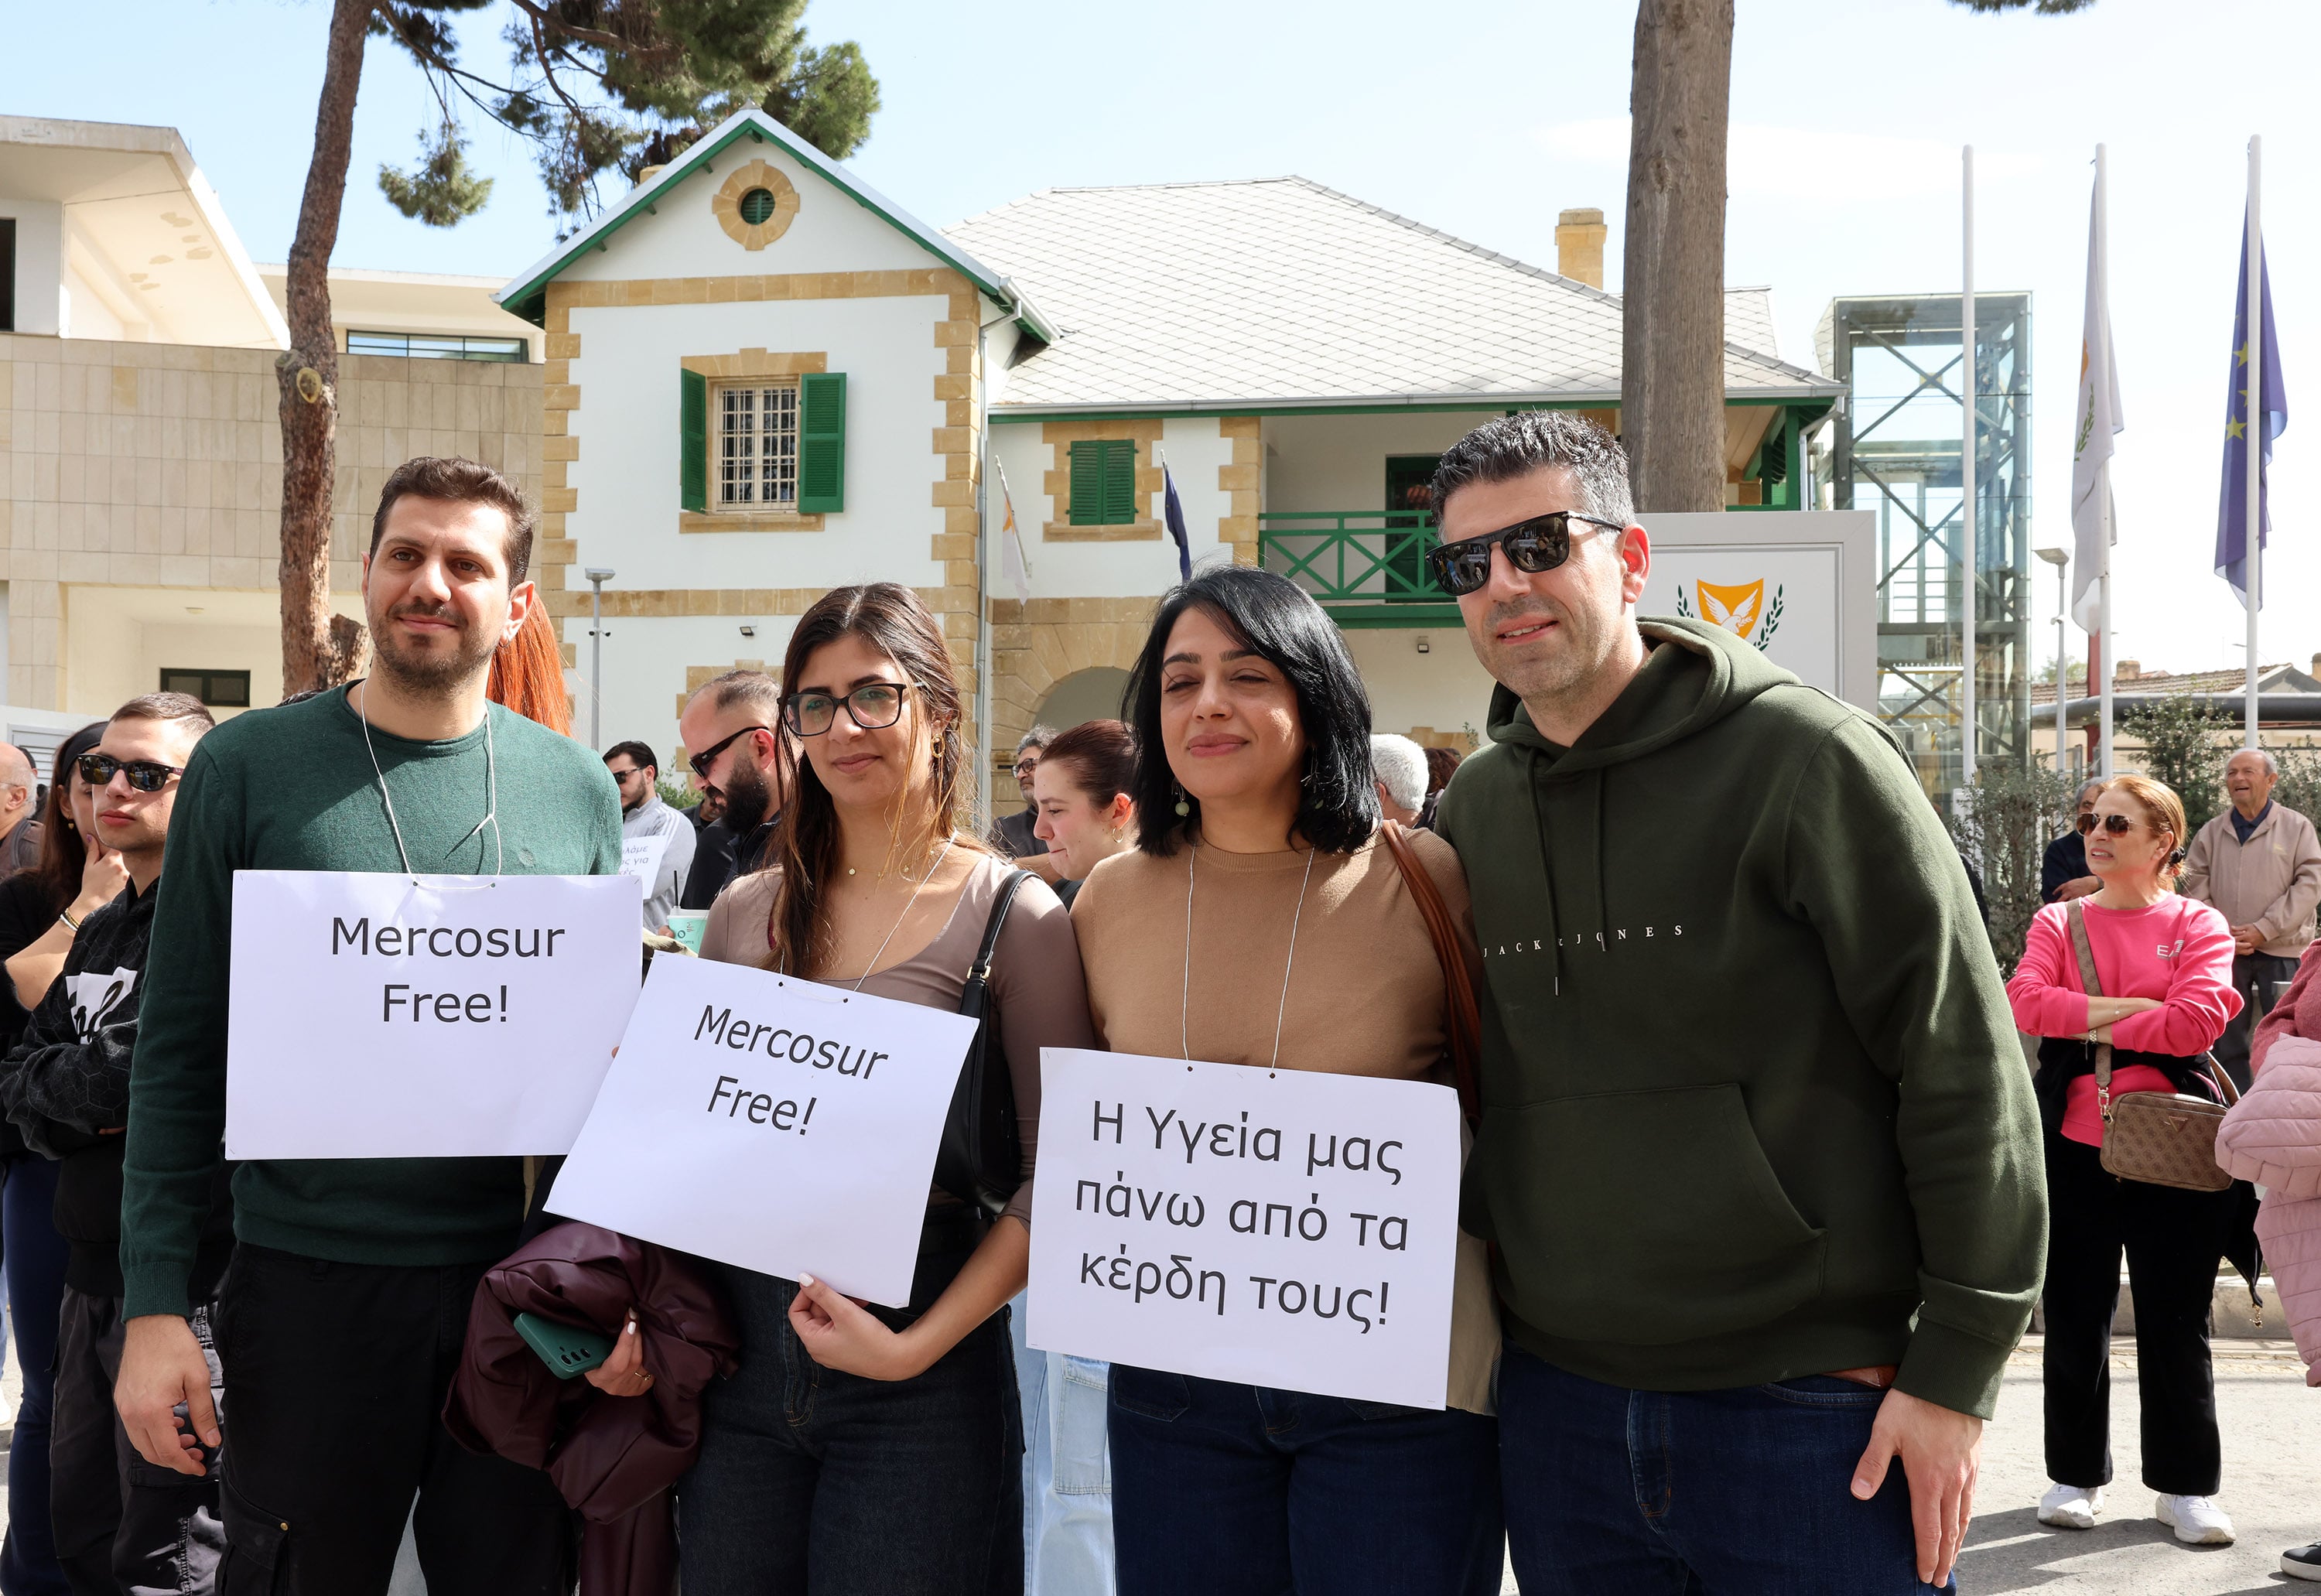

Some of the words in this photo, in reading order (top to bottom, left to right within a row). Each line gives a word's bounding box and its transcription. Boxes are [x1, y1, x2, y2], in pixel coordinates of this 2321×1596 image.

[634, 857, 649, 866] για
[333, 917, 566, 958] Mercosur
[1484, 938, 1542, 959] JACK
[383, 984, 508, 1023] Free!
[694, 1004, 889, 1080] Mercosur
[707, 1075, 817, 1136] Free!
[1093, 1100, 1123, 1144] Η
[1145, 1106, 1282, 1164] Υγεία
[1307, 1133, 1403, 1186] μας
[1076, 1170, 1205, 1228] πάνω
[1229, 1192, 1328, 1242] από
[1349, 1212, 1408, 1251] τα
[1081, 1243, 1226, 1316] κέρδη
[1249, 1276, 1389, 1335] τους!
